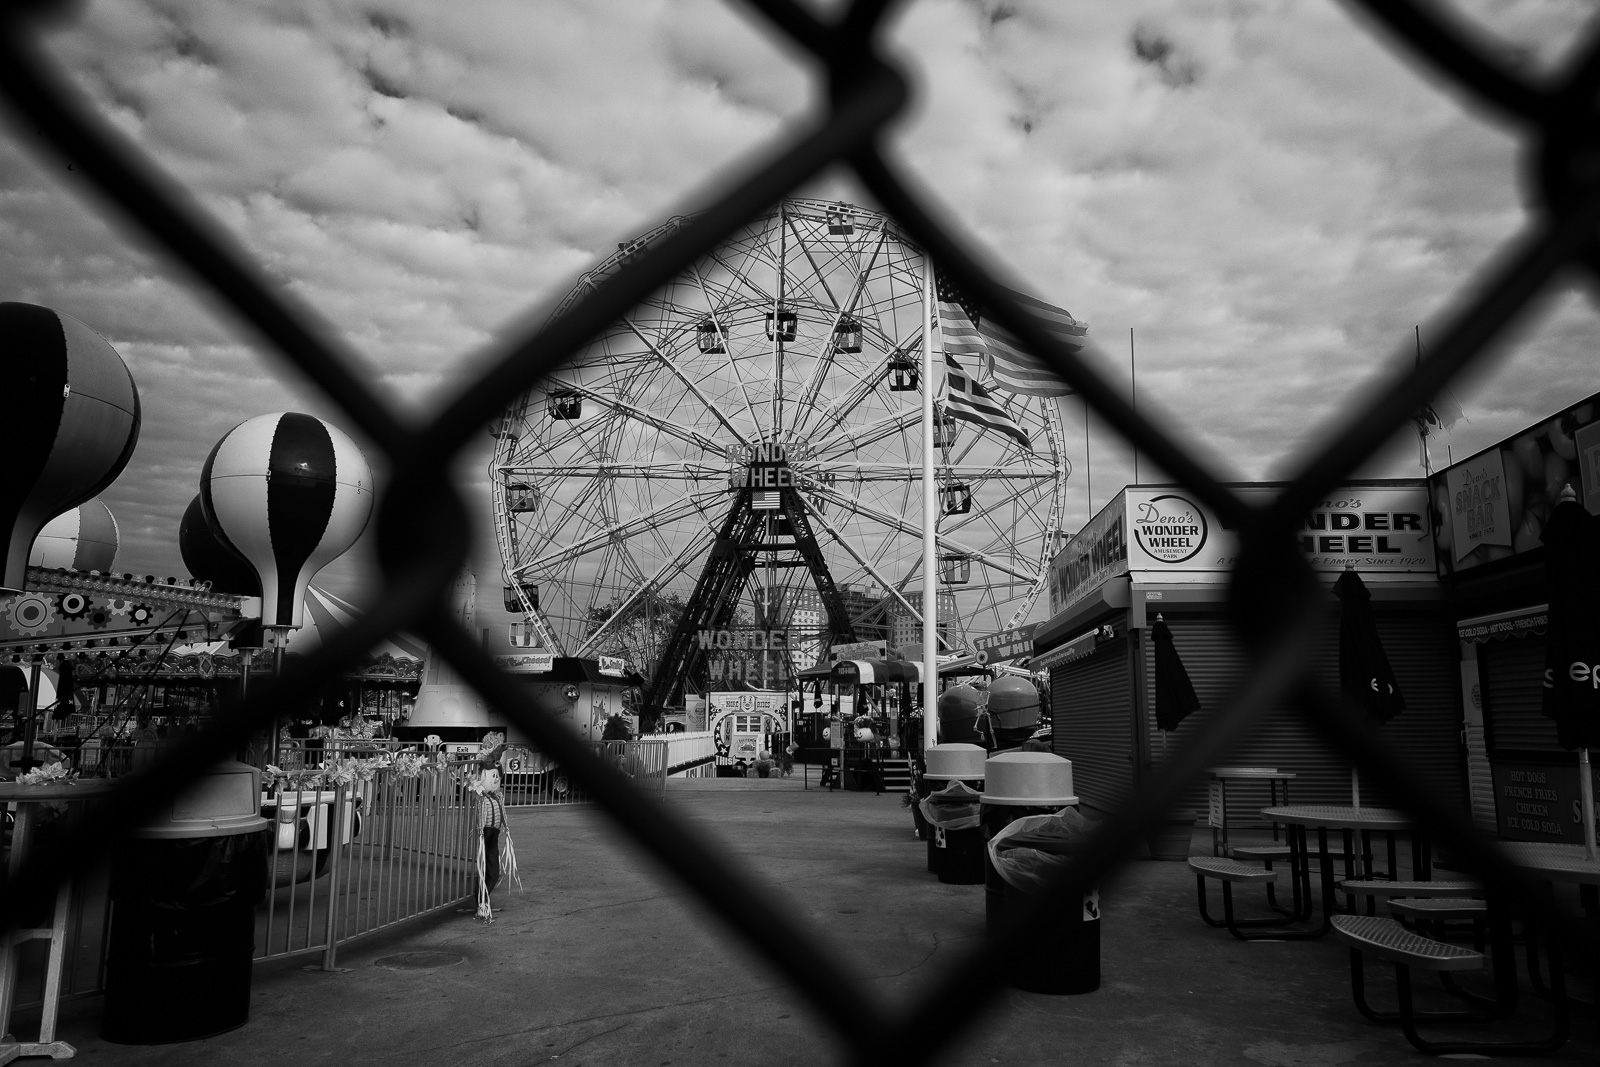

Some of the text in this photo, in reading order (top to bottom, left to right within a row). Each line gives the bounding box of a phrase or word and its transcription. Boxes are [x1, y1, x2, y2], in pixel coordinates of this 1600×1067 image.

[725, 443, 809, 463] WONDER
[731, 467, 802, 487] WHEEL
[1462, 468, 1488, 486] Deno's
[1455, 475, 1501, 515] SNACK
[1136, 503, 1194, 524] Deno's
[1466, 502, 1495, 533] BAR
[1142, 525, 1199, 536] WONDER
[1148, 537, 1194, 548] WHEEL
[1297, 536, 1402, 553] HEEL
[1059, 552, 1090, 603] WONDER
[1091, 515, 1127, 574] WHEEL
[1399, 557, 1426, 565] 1920
[1499, 621, 1513, 632] DOGS
[1515, 617, 1535, 630] FRENCH
[512, 760, 519, 769] 5
[1510, 770, 1547, 784] HOT DOGS
[1504, 785, 1558, 801] FRENCH FRIES
[1516, 802, 1549, 816] CHICKEN
[1507, 816, 1564, 836] ICE COLD SODA
